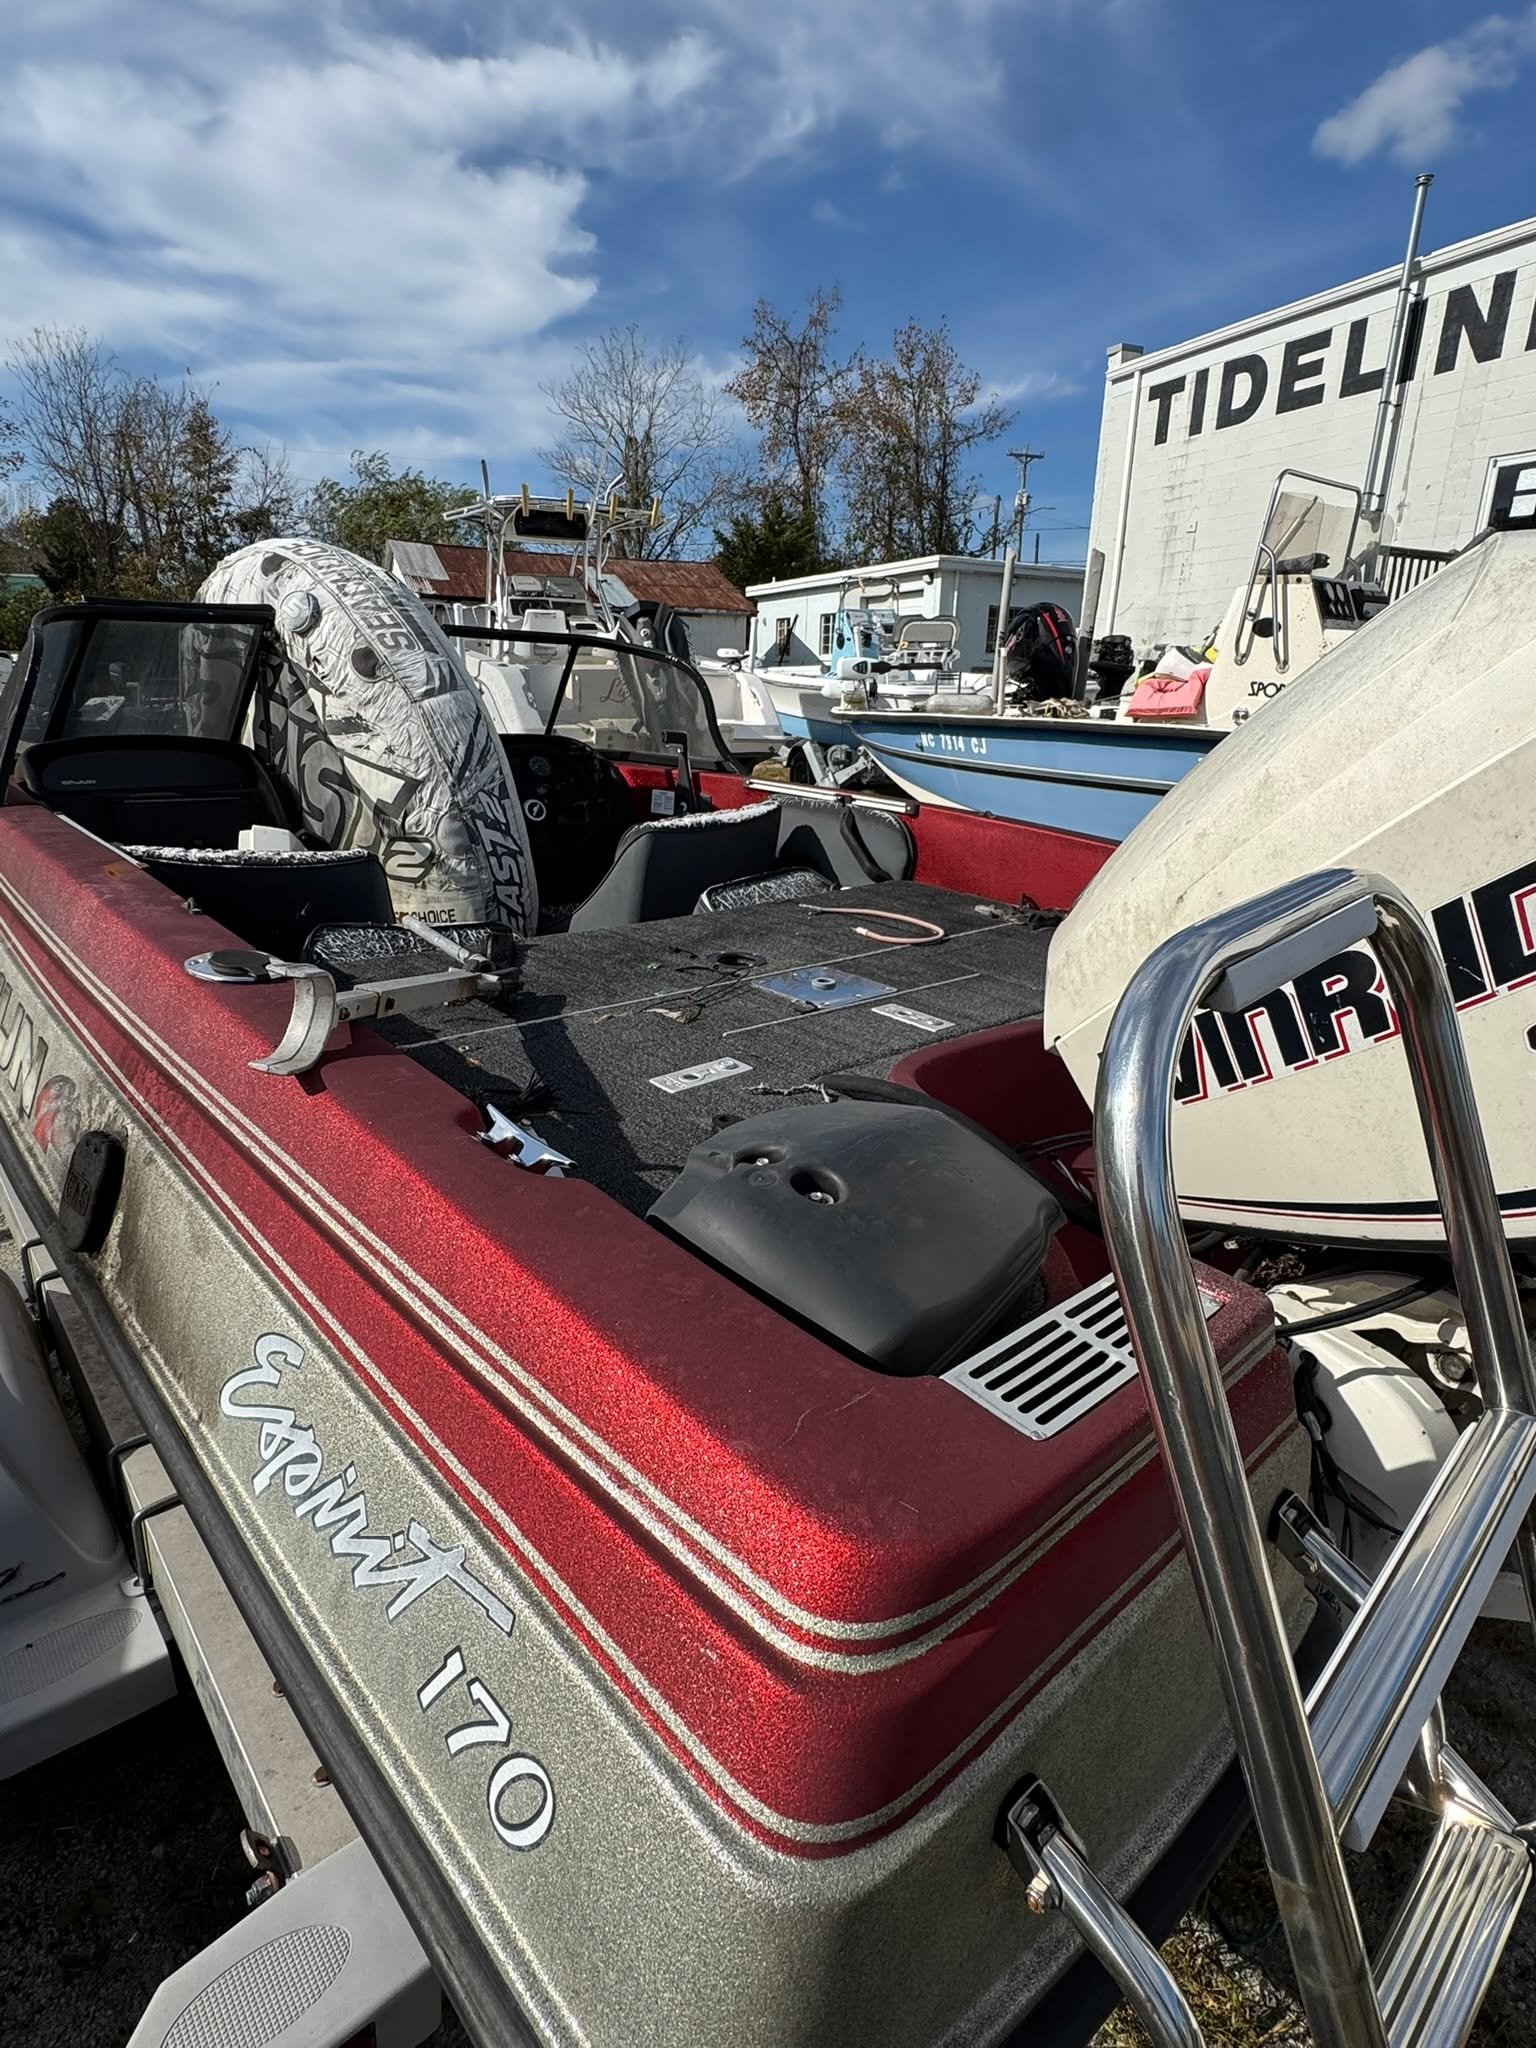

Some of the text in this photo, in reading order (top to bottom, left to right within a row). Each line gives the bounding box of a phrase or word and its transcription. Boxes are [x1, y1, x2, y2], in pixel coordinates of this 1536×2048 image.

[1148, 270, 1536, 446] TIDELIN
[971, 737, 987, 755] CJ
[416, 1645, 556, 1852] 170
